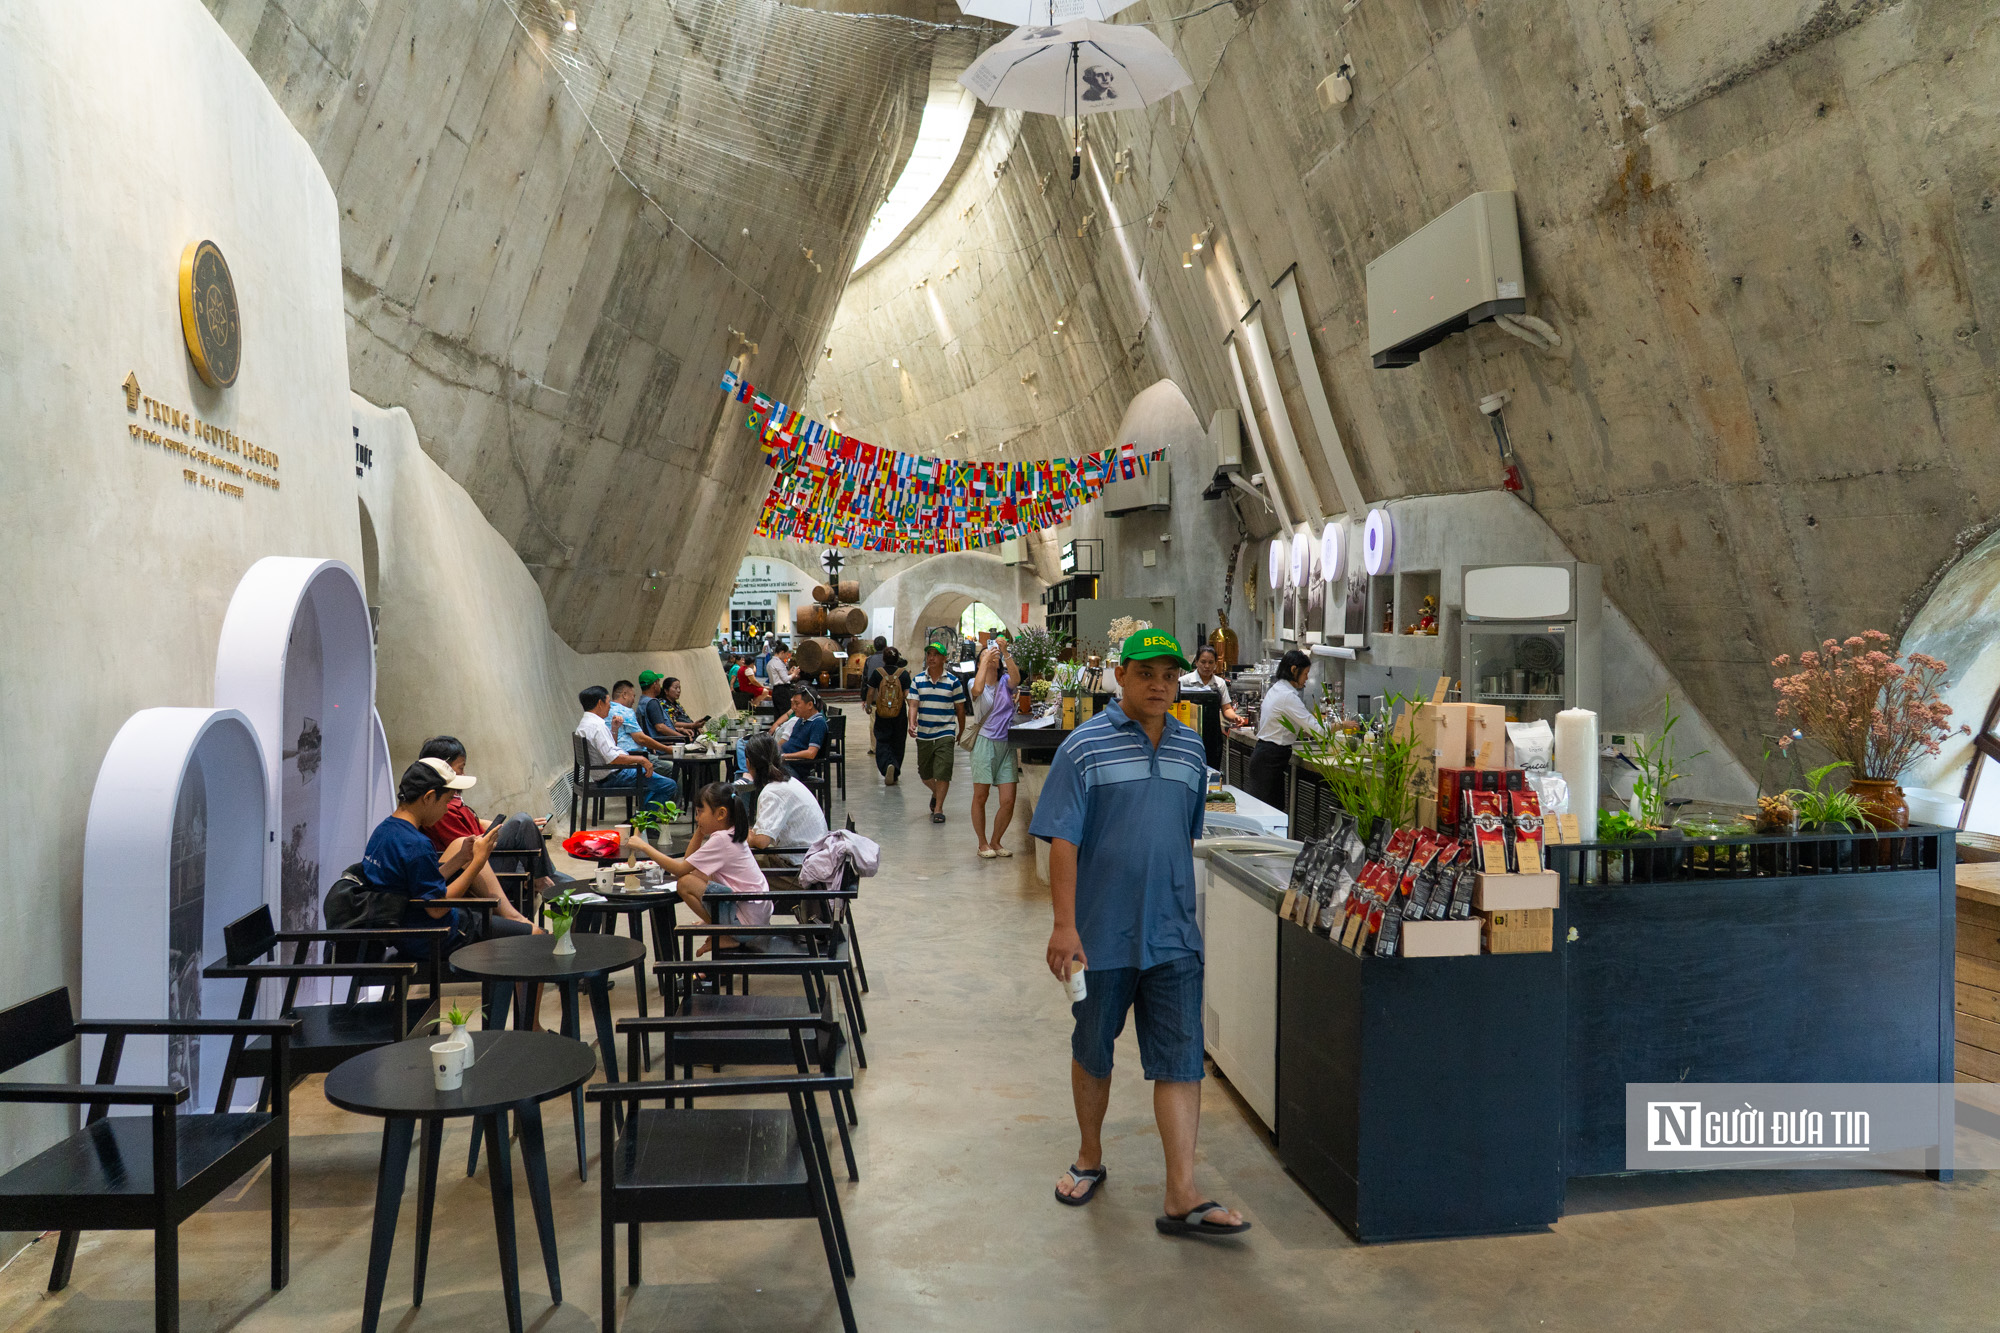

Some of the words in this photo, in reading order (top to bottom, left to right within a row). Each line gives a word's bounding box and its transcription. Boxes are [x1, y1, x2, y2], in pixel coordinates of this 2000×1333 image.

[143, 395, 191, 432] TRUNG
[194, 418, 240, 453] NGUYÊN
[242, 439, 279, 470] LEGEND
[1143, 636, 1178, 652] BESCO
